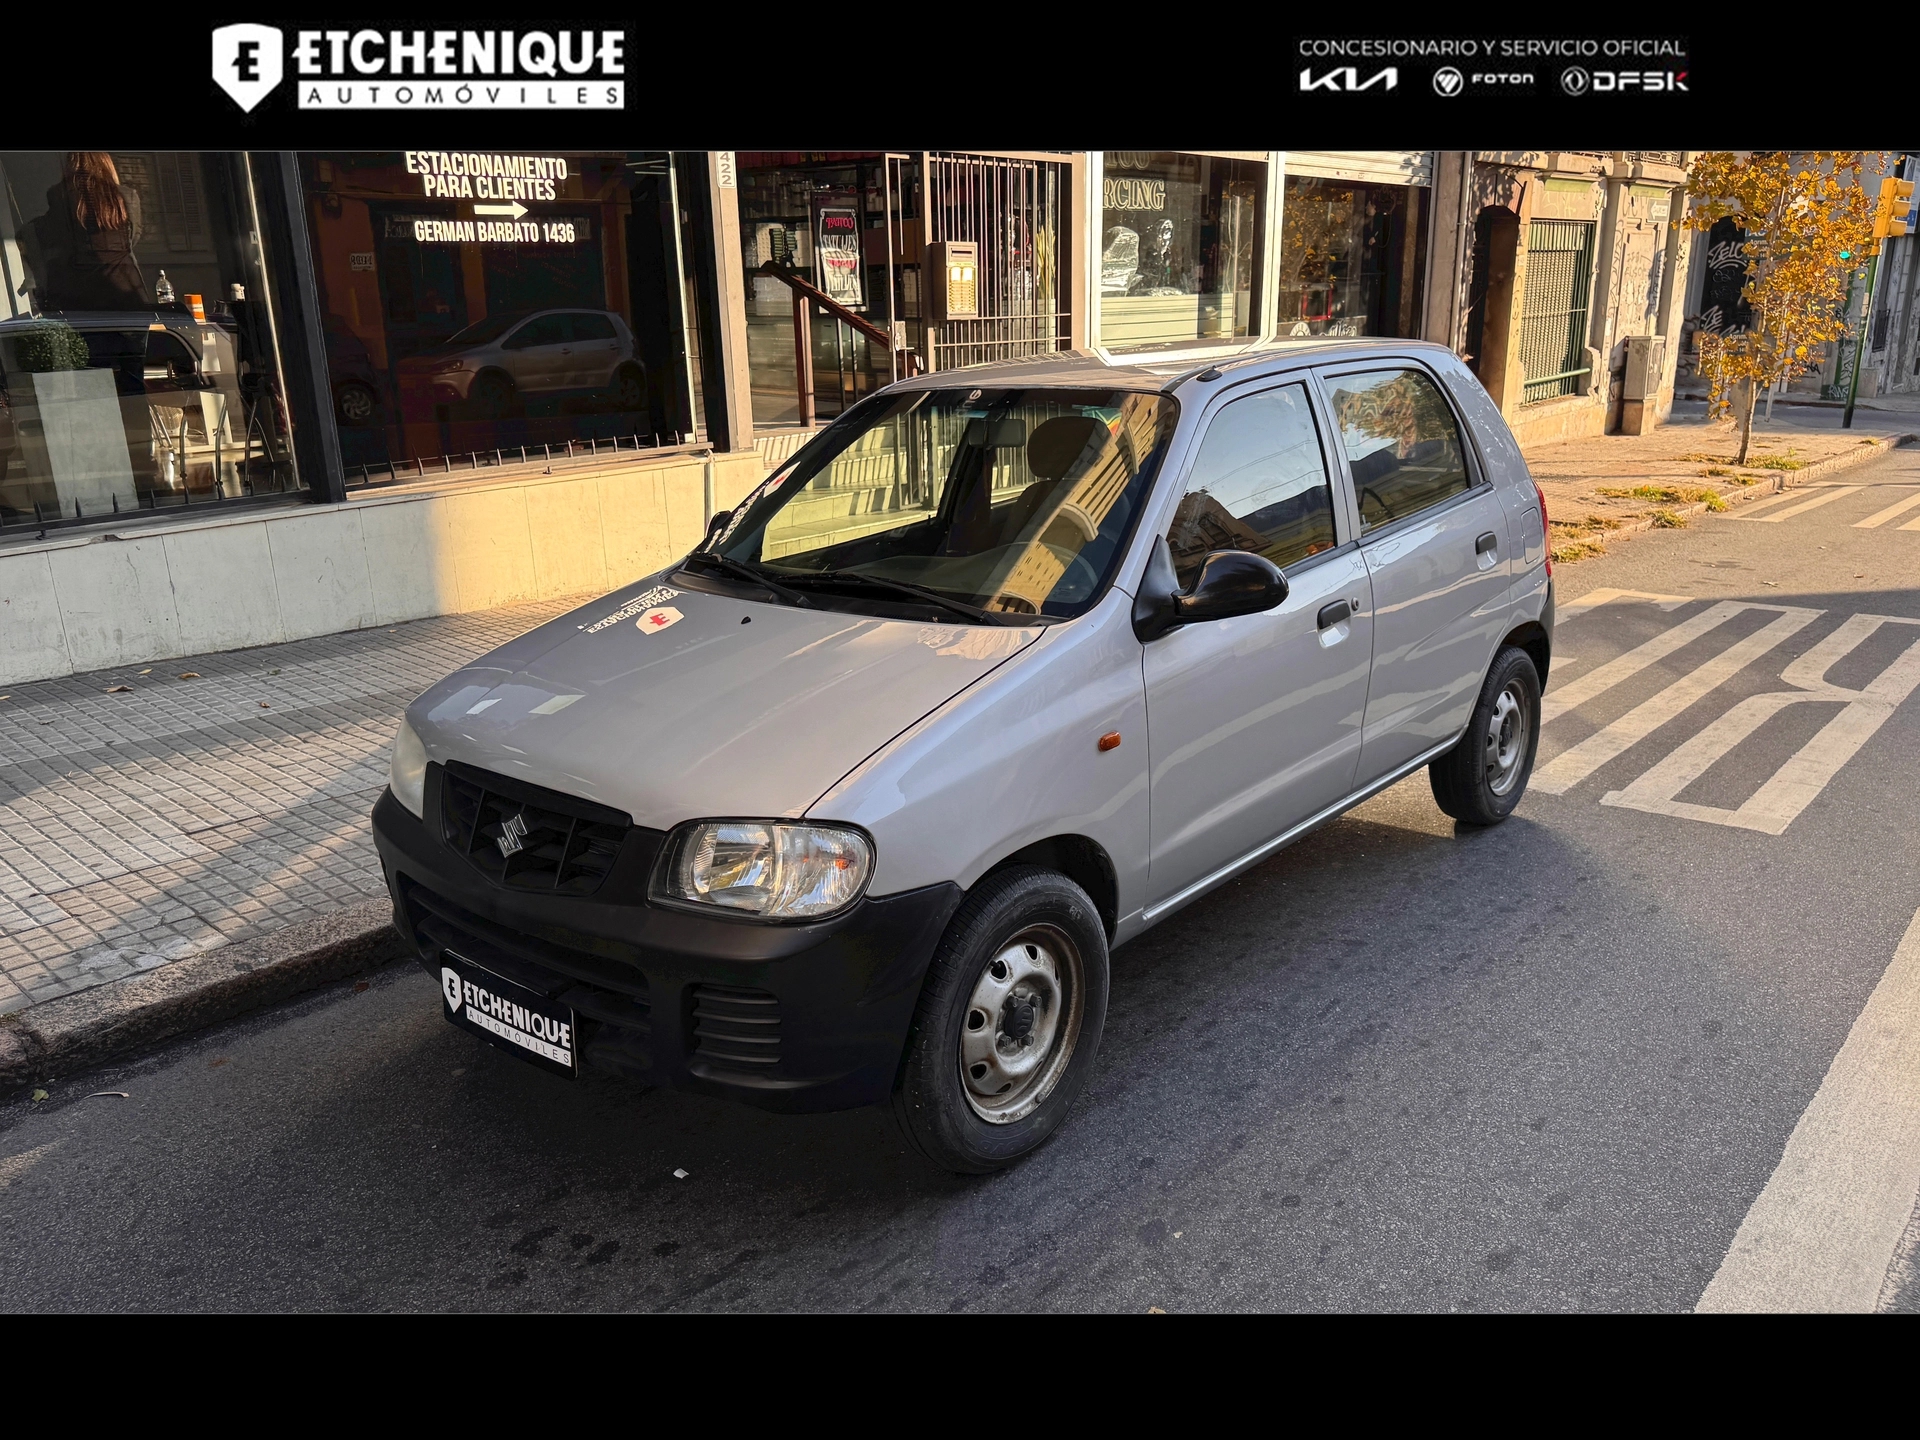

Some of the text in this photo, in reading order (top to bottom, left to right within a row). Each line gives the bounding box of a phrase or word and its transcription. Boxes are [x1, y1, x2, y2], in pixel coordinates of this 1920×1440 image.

[405, 151, 568, 180] ESTACIONAMIENTO
[423, 174, 557, 201] PARA CLIENTES
[414, 220, 476, 242] GERMAN
[477, 221, 540, 243] BARBATO
[543, 222, 576, 243] 1436
[463, 980, 571, 1049] ETCHENIQUE
[468, 1009, 570, 1064] AUTOMÓVILES
